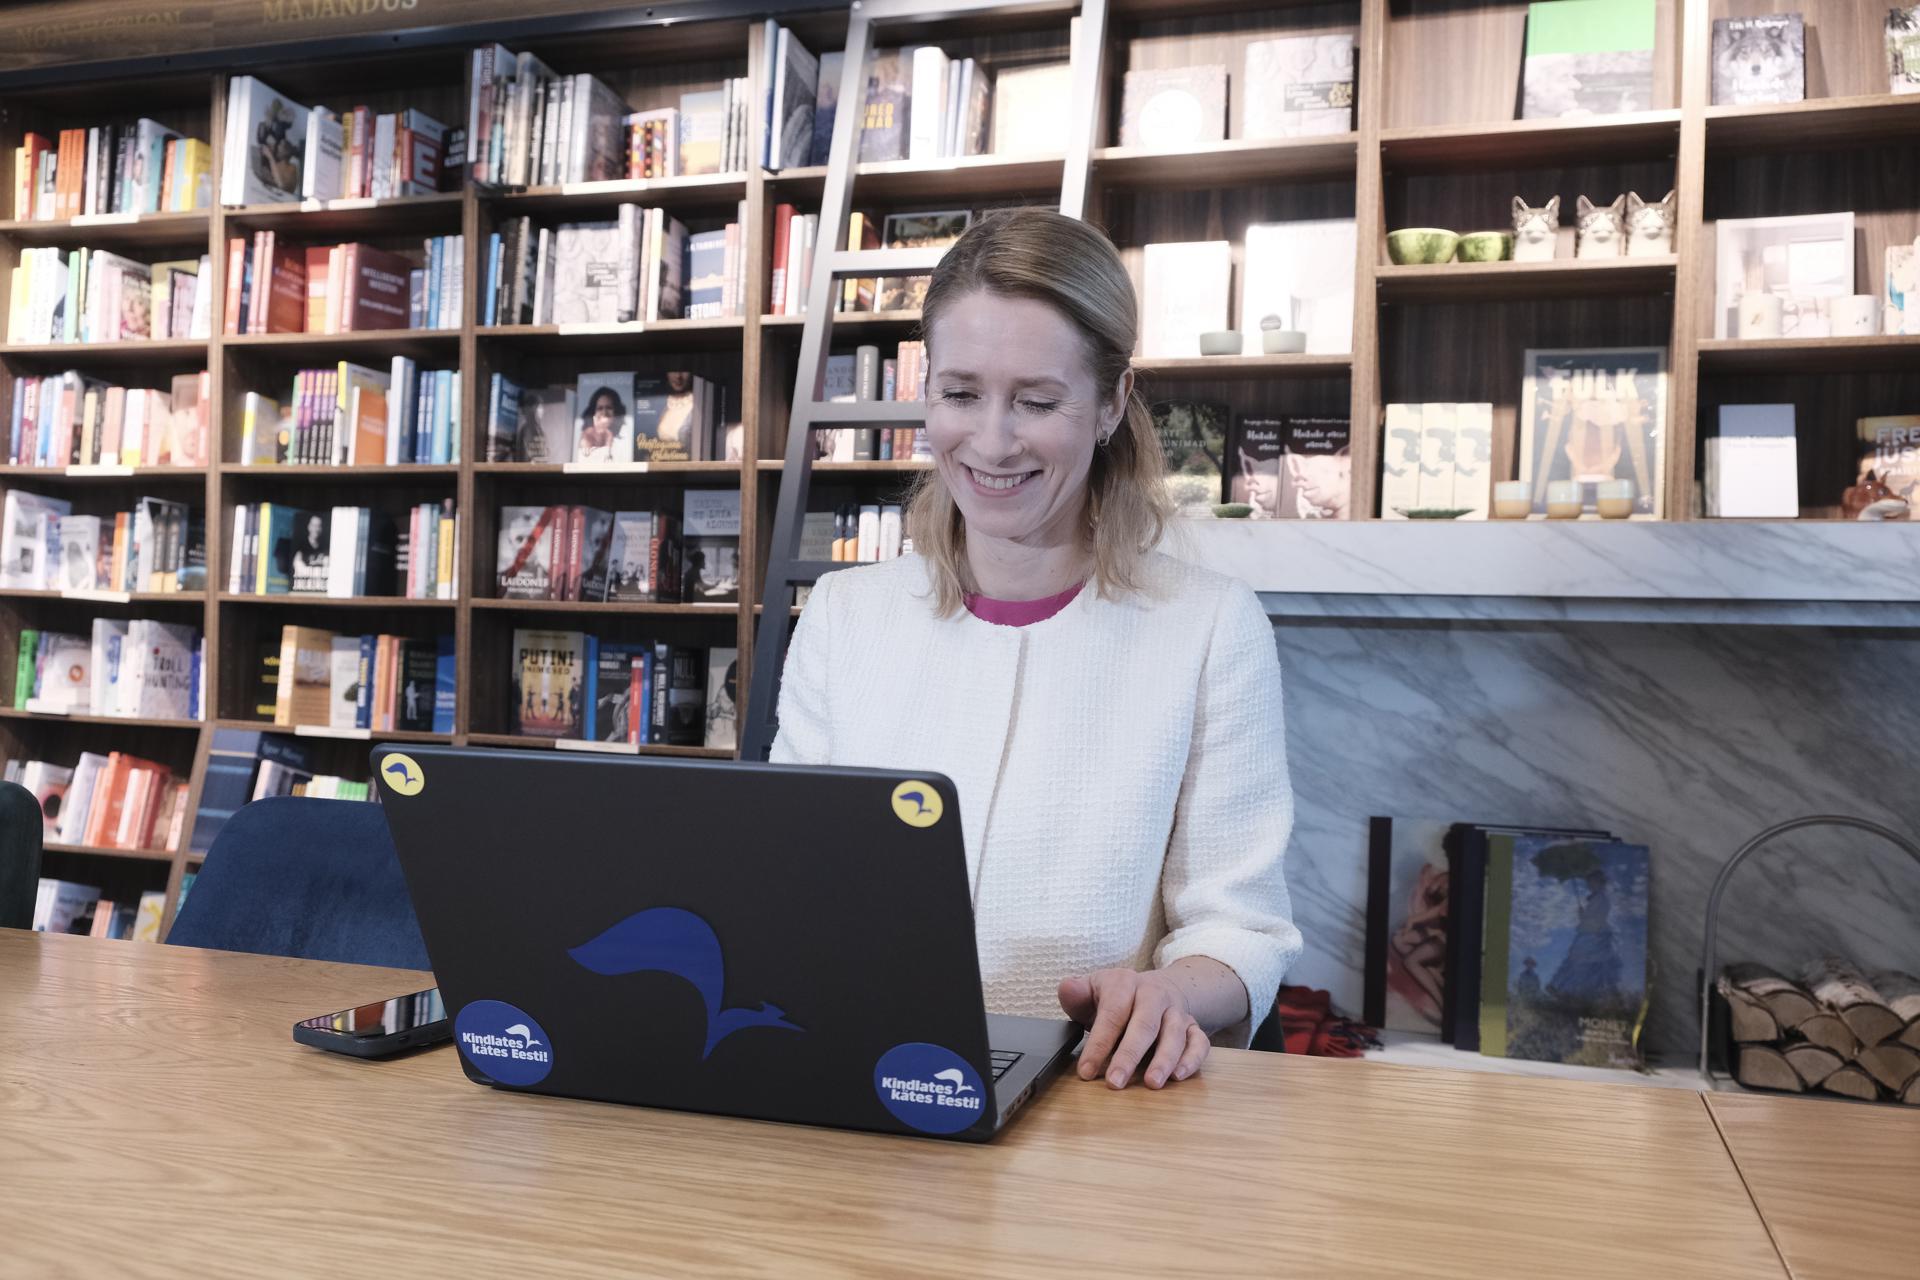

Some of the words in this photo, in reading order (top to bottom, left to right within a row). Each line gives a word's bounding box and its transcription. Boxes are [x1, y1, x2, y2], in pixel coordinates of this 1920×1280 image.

[264, 0, 417, 25] MAJANDUS
[153, 656, 183, 673] TROLL
[519, 648, 574, 667] PUTINI
[144, 673, 189, 690] HUNTING
[1578, 1017, 1628, 1033] MONET
[462, 1032, 524, 1050] Kindlates
[472, 1044, 509, 1058] kätes
[511, 1048, 549, 1063] Eesti!
[882, 1077, 954, 1096] Kindlates
[891, 1089, 934, 1104] kätes
[936, 1095, 980, 1110] Eesti!
